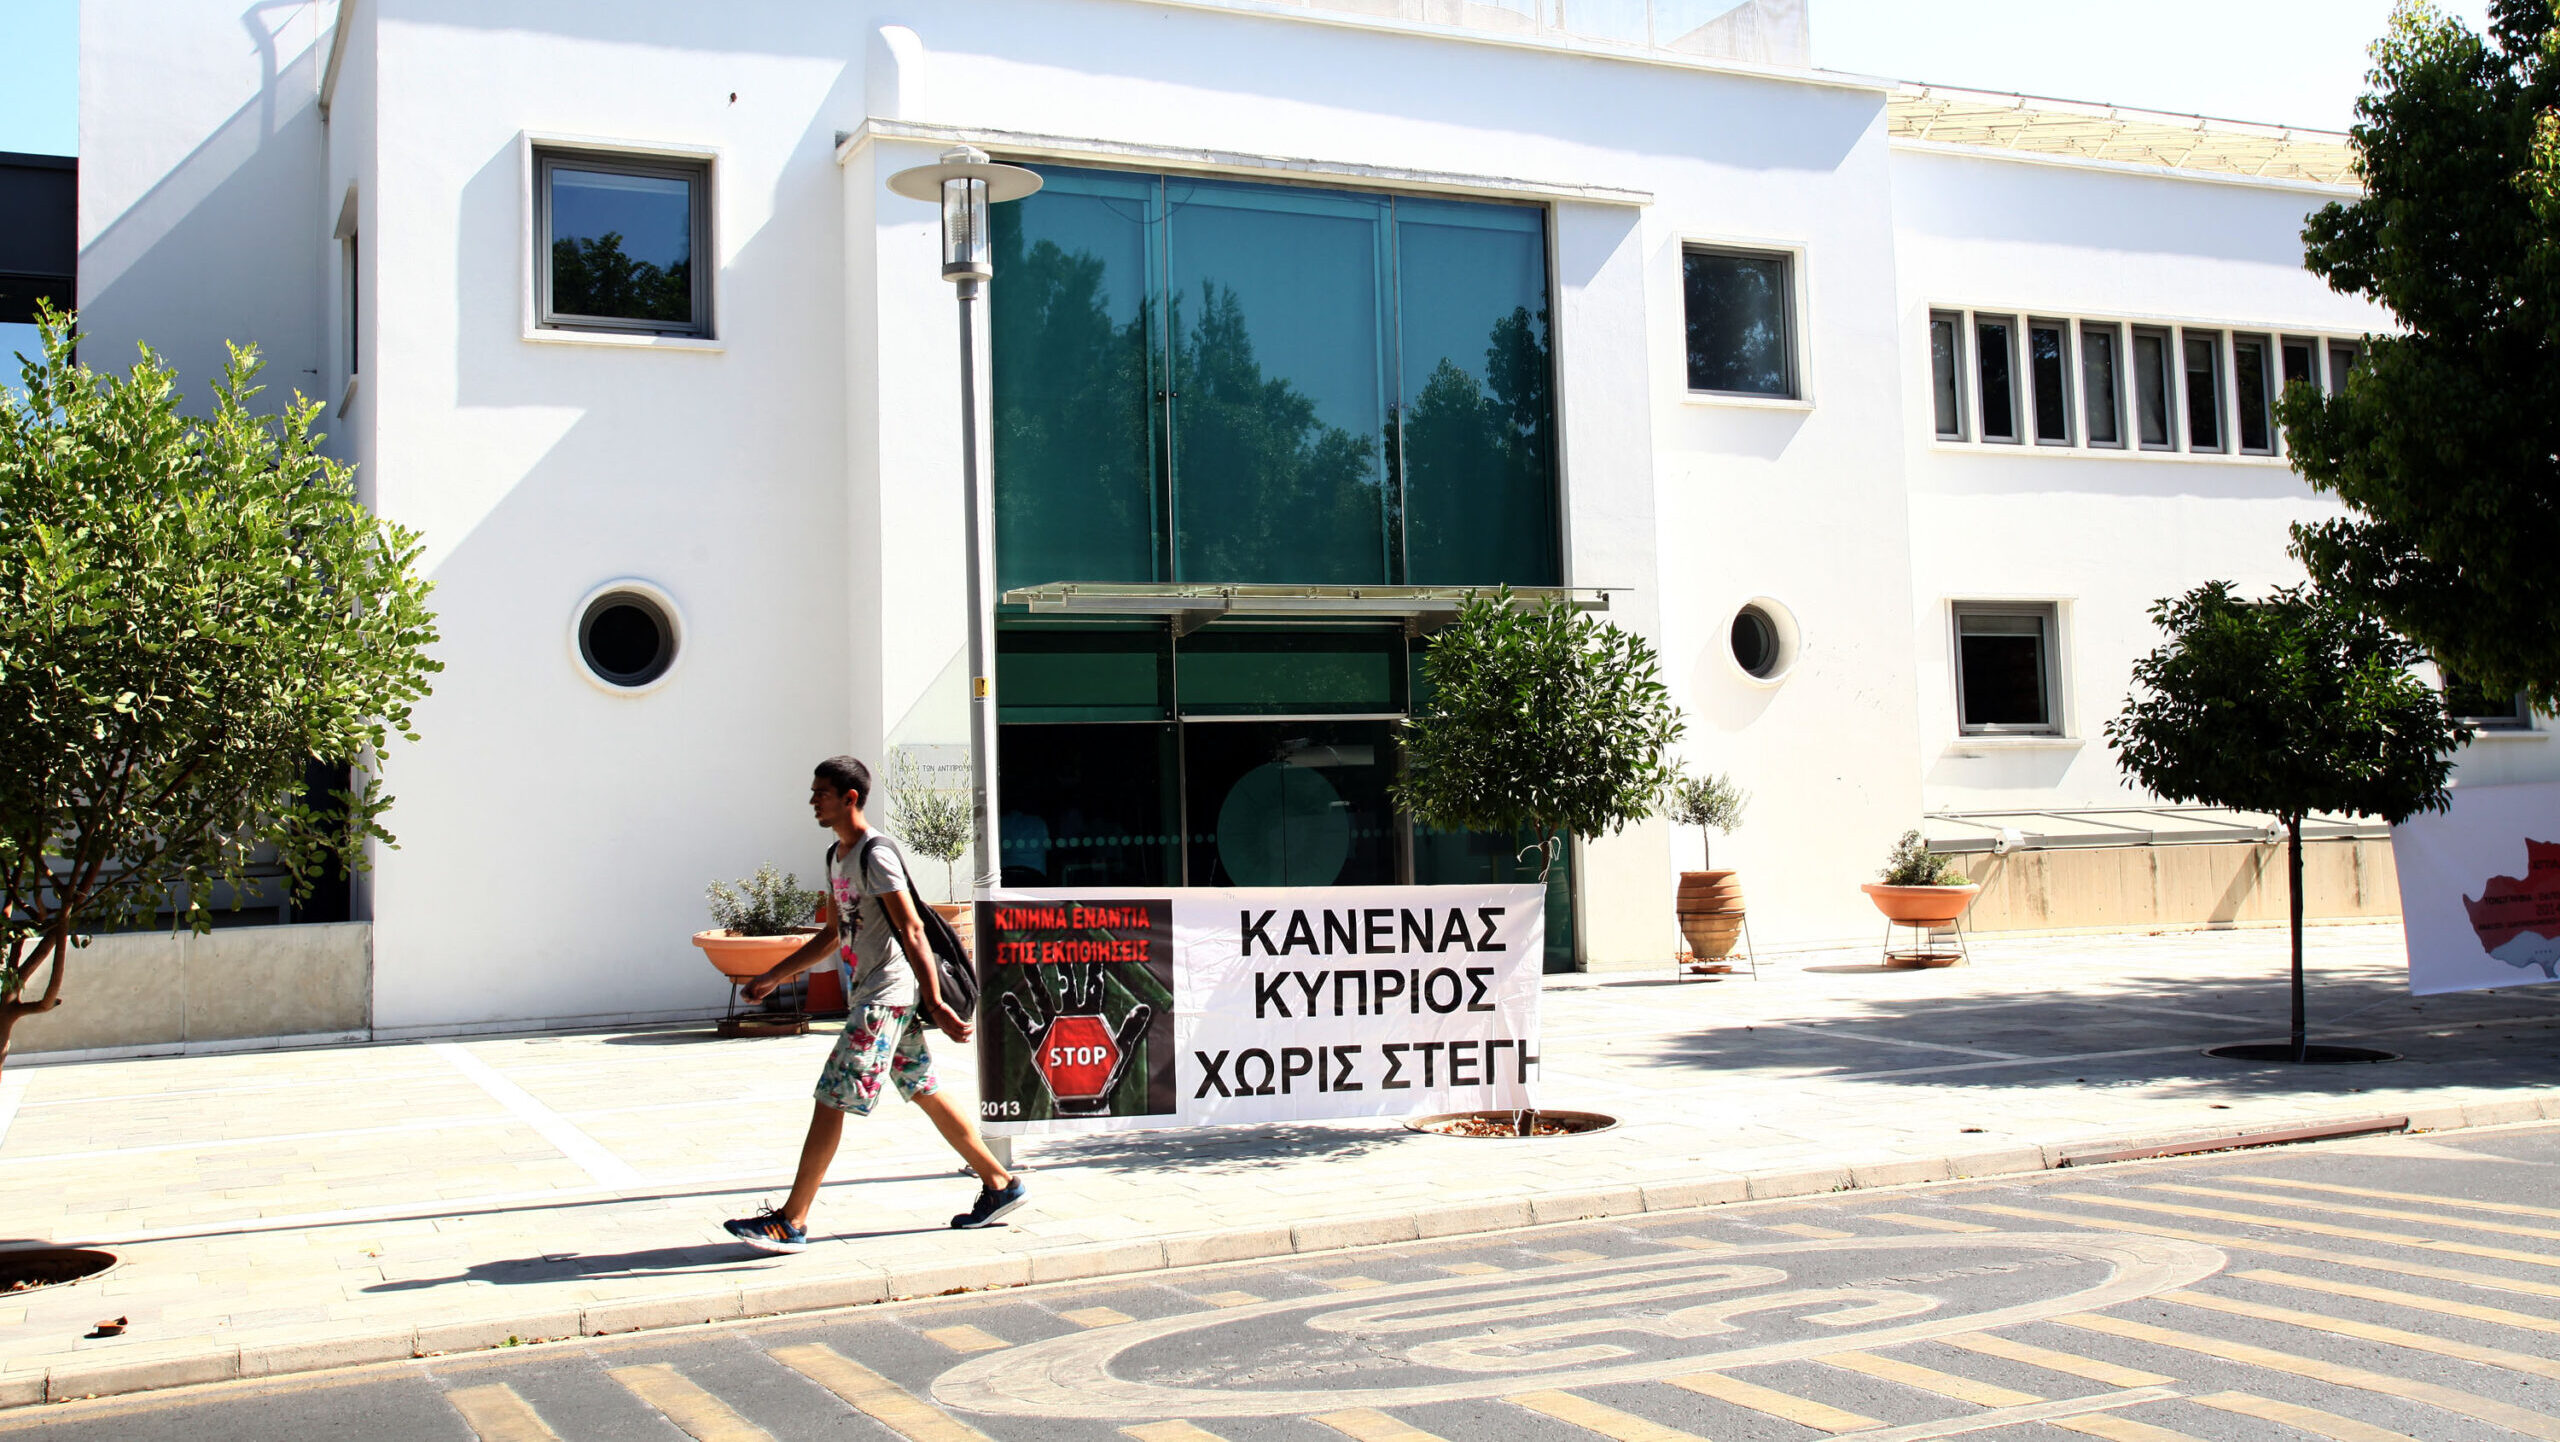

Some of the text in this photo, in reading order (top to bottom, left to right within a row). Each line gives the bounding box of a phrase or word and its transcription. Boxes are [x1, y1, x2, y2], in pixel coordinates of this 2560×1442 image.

[994, 906, 1150, 930] ΚΙΝΗΜΑ ΕΝΑΝΤΙΑ
[1241, 907, 1507, 957] ΚΑΝΕΝΑΣ
[996, 940, 1150, 964] ΣΤΙΣ ΕΚΠΟΙΗΣΕΙΣ
[1255, 967, 1496, 1018] ΚΥΠΡΙΟΣ
[1050, 1046, 1107, 1067] STOP
[1194, 1045, 1363, 1099] ΧΩΡΙΣ
[981, 1101, 1021, 1116] 2013
